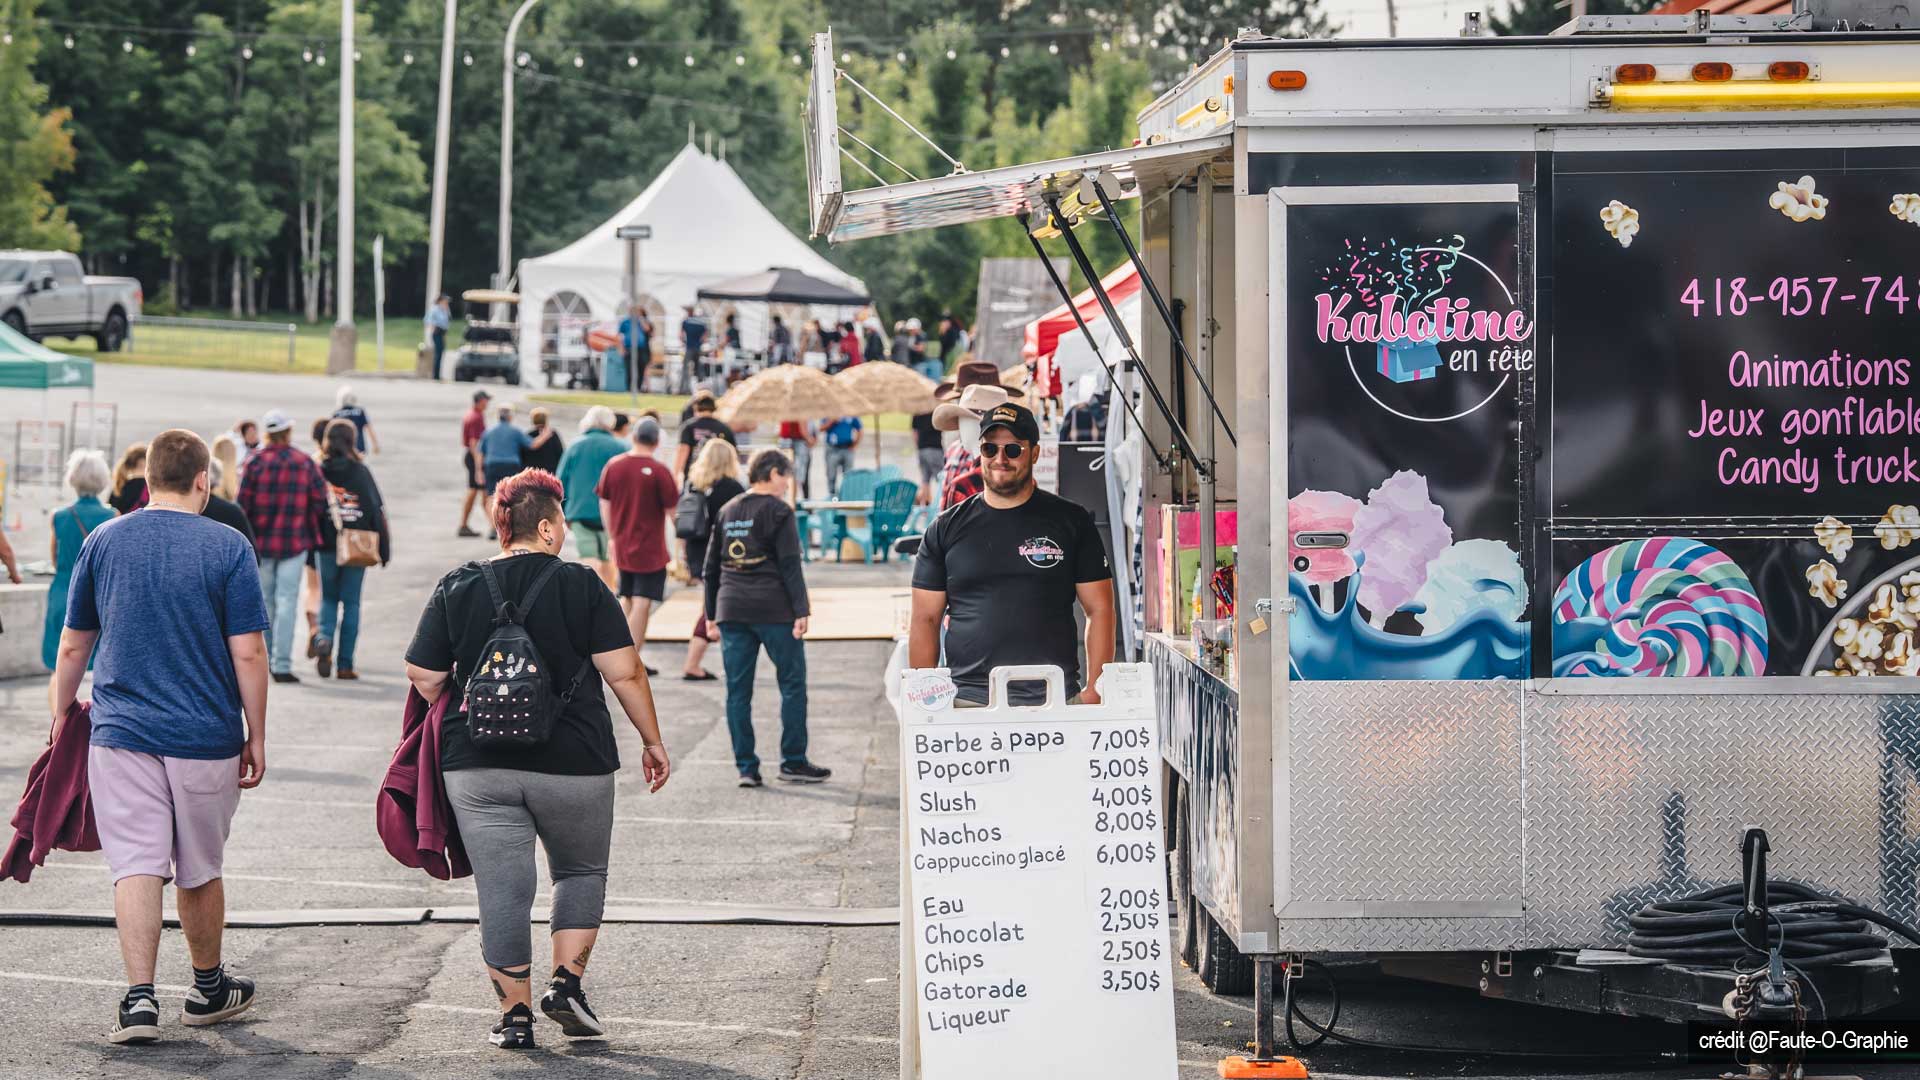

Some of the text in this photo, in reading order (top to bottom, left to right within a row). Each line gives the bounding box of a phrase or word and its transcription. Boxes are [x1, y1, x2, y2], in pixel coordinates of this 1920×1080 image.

[1680, 276, 1920, 317] 418-957-74
[1314, 293, 1533, 343] Kabotine
[1449, 345, 1533, 372] en fête
[1728, 350, 1911, 387] Animations
[1688, 399, 1764, 438] Jeux
[1718, 446, 1920, 493] Candy truck
[915, 727, 1150, 754] Barbe à papa 7,00$
[917, 757, 1149, 783] Popcorn 5,00$
[919, 785, 1153, 813] Slush 4,00$
[920, 810, 1157, 847] Nachos 8,00$
[1096, 842, 1157, 865] 6,00$
[923, 887, 1160, 917] Eau 2,00$
[925, 911, 1159, 944] Chocolat 2,50$
[925, 939, 1161, 975] Chips 2,50$
[924, 970, 1160, 1001] Gatorade 3,50$
[927, 1007, 1011, 1034] Liqueur
